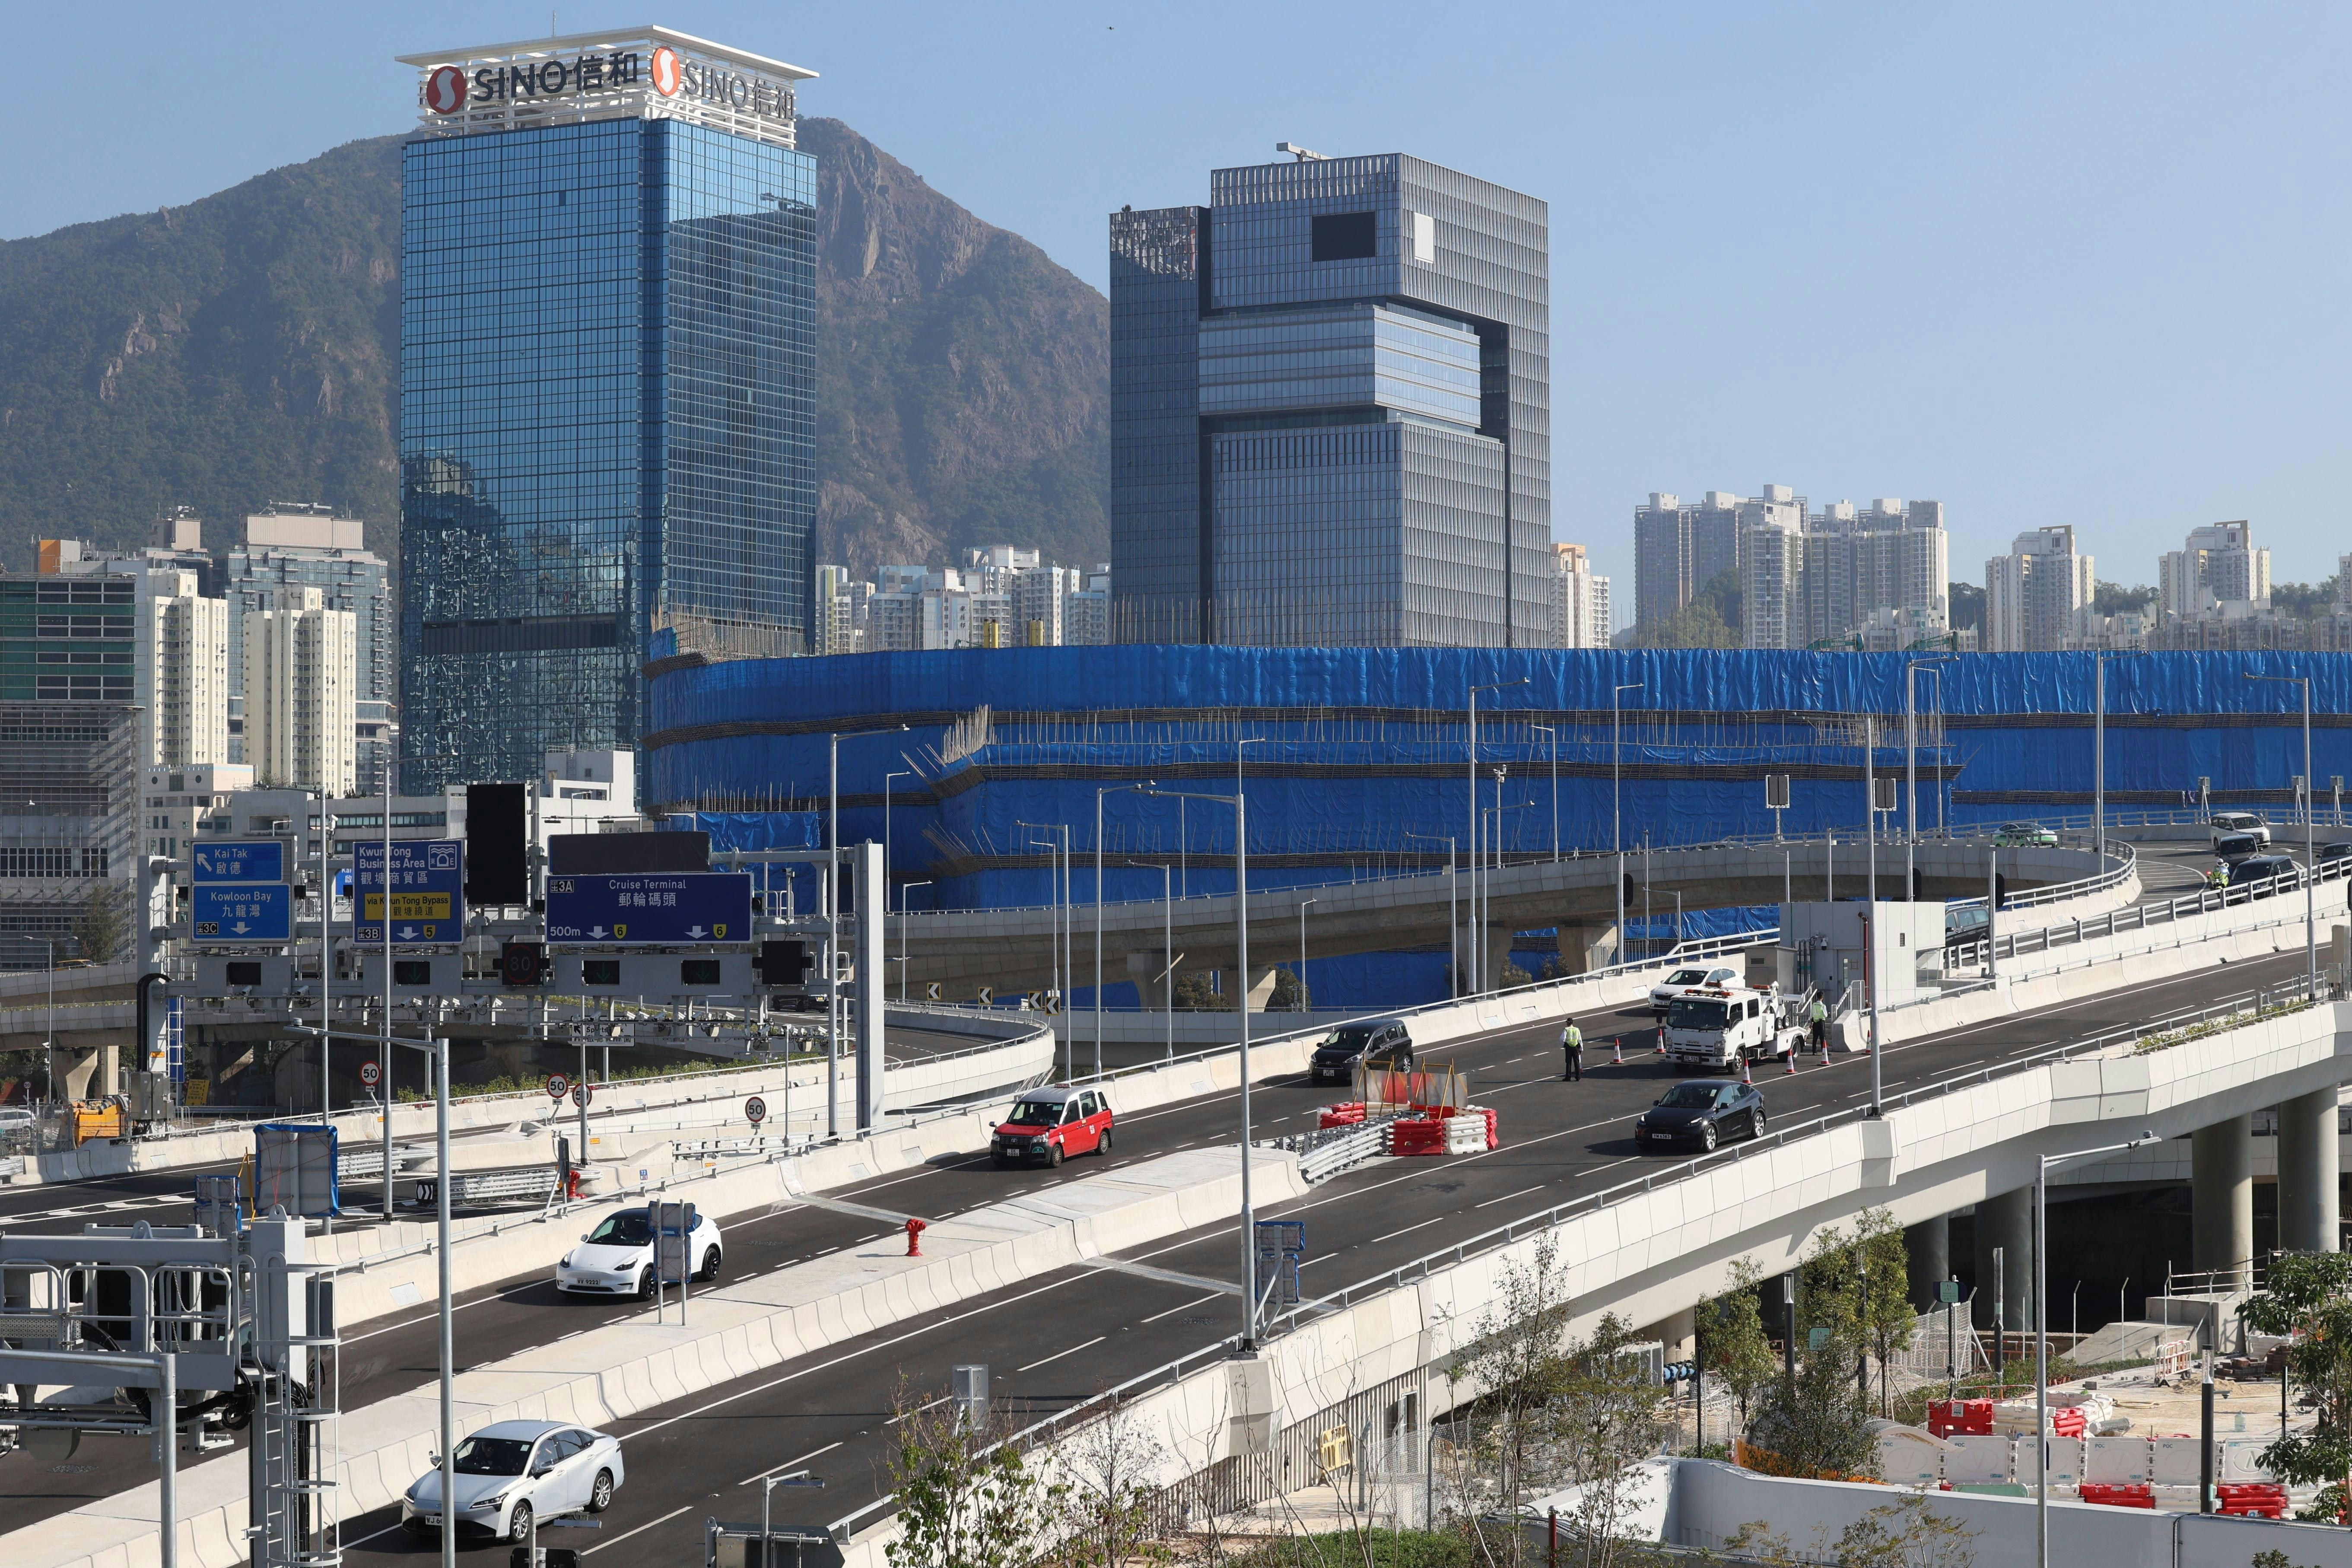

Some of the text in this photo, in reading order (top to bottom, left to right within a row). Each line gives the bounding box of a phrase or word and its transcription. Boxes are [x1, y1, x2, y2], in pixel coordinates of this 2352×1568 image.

[573, 51, 637, 91] 信和
[474, 60, 566, 102] SINO
[685, 61, 748, 108] SINO
[752, 78, 795, 120] 信和
[215, 849, 248, 858] Kai Tak
[389, 846, 411, 858] Tong
[359, 858, 425, 868] Businss Area
[216, 862, 241, 875] 啟德
[361, 871, 428, 884] 觀塘商貿區
[559, 881, 572, 891] 3A
[609, 879, 686, 889] Cruise Terminal
[211, 891, 271, 902] Kowloon Bay
[402, 897, 420, 906] Tong
[423, 896, 448, 905] Bypass
[618, 892, 676, 906] 郵輪碼頭
[222, 904, 260, 917] 九龍灣
[383, 906, 433, 916] 觀塘繞道
[204, 924, 216, 933] 3C
[366, 929, 378, 938] 3B
[426, 927, 432, 937] 5
[550, 926, 581, 936] 500m
[617, 927, 623, 935] 6
[716, 927, 722, 935] 6
[511, 957, 530, 971] 80
[363, 1069, 377, 1078] 50
[550, 1081, 564, 1091] 50
[576, 1091, 588, 1100] 5
[748, 1105, 763, 1115] 50
